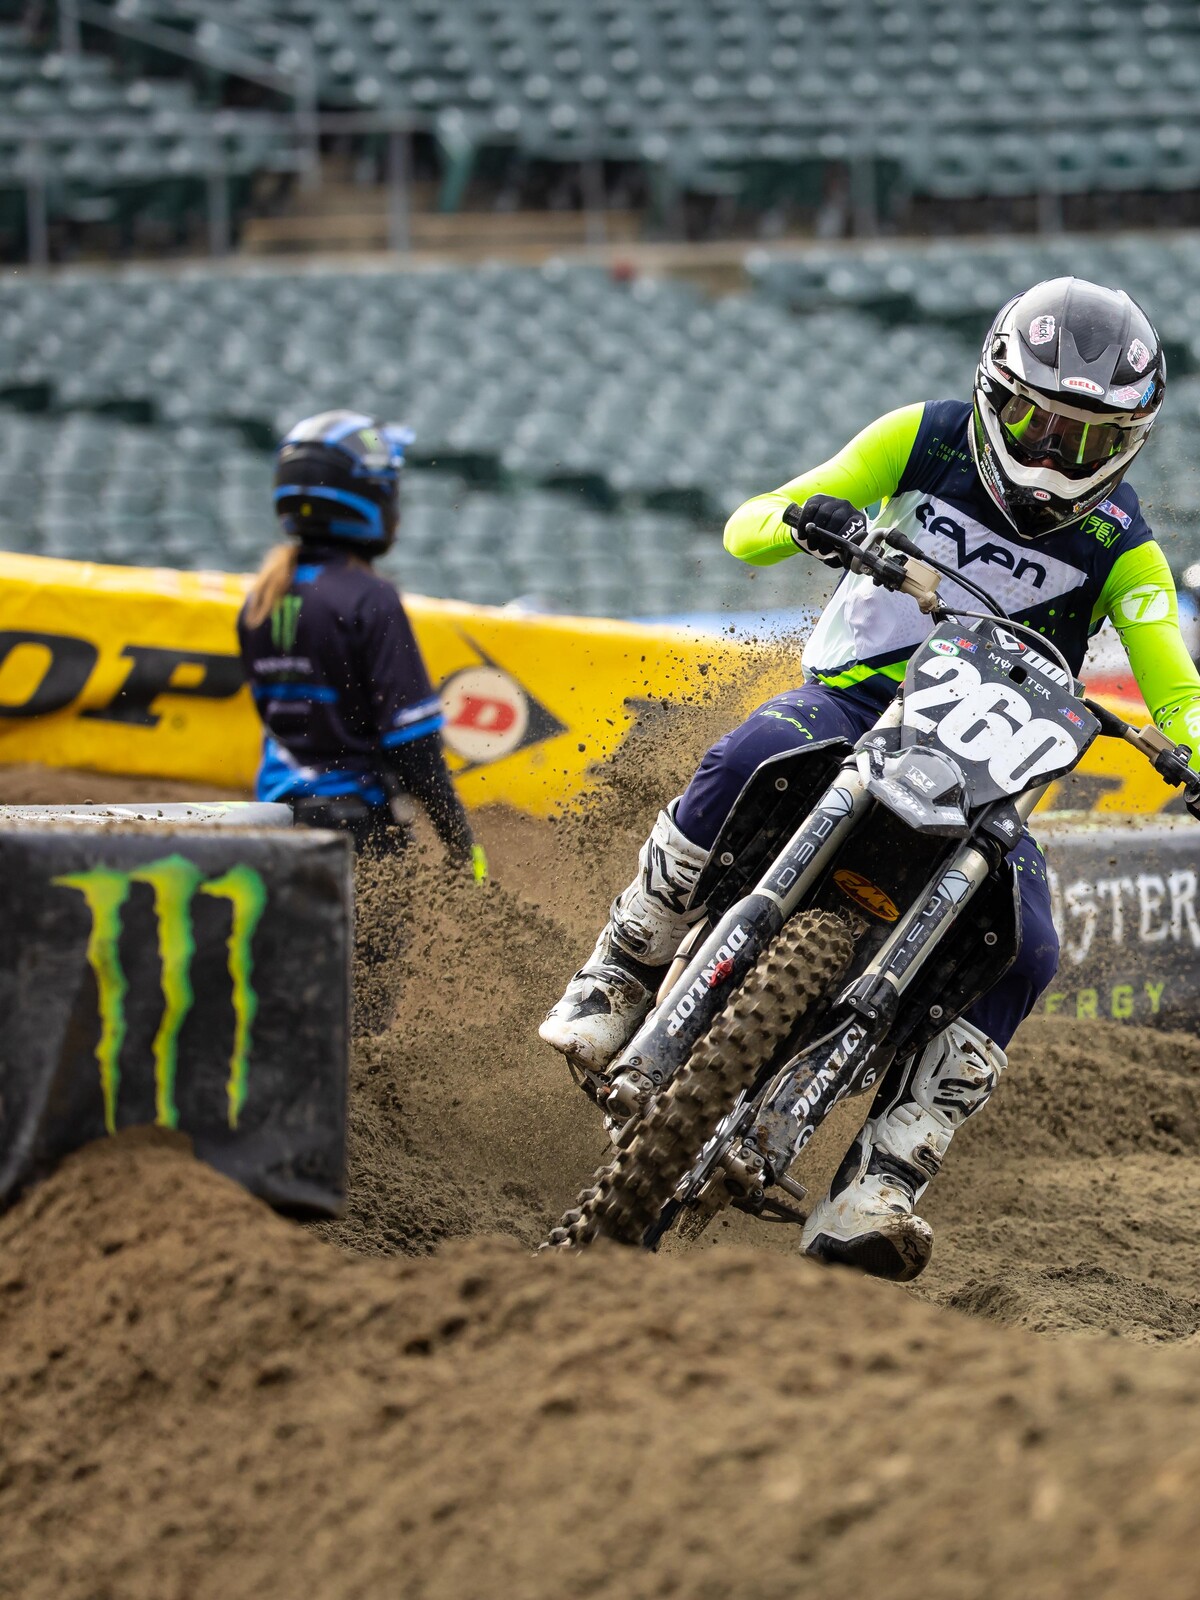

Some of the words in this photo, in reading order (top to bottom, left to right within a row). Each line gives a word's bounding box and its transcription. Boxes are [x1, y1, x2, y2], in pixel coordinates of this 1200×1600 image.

[1069, 379, 1098, 392] BELL
[1036, 491, 1049, 499] BELL
[1131, 591, 1159, 620] 7
[953, 635, 978, 654] AMA
[988, 652, 1052, 701] MOTER
[993, 666, 1038, 697] ENGY
[904, 655, 1078, 795] 260
[1057, 706, 1086, 730] AMA
